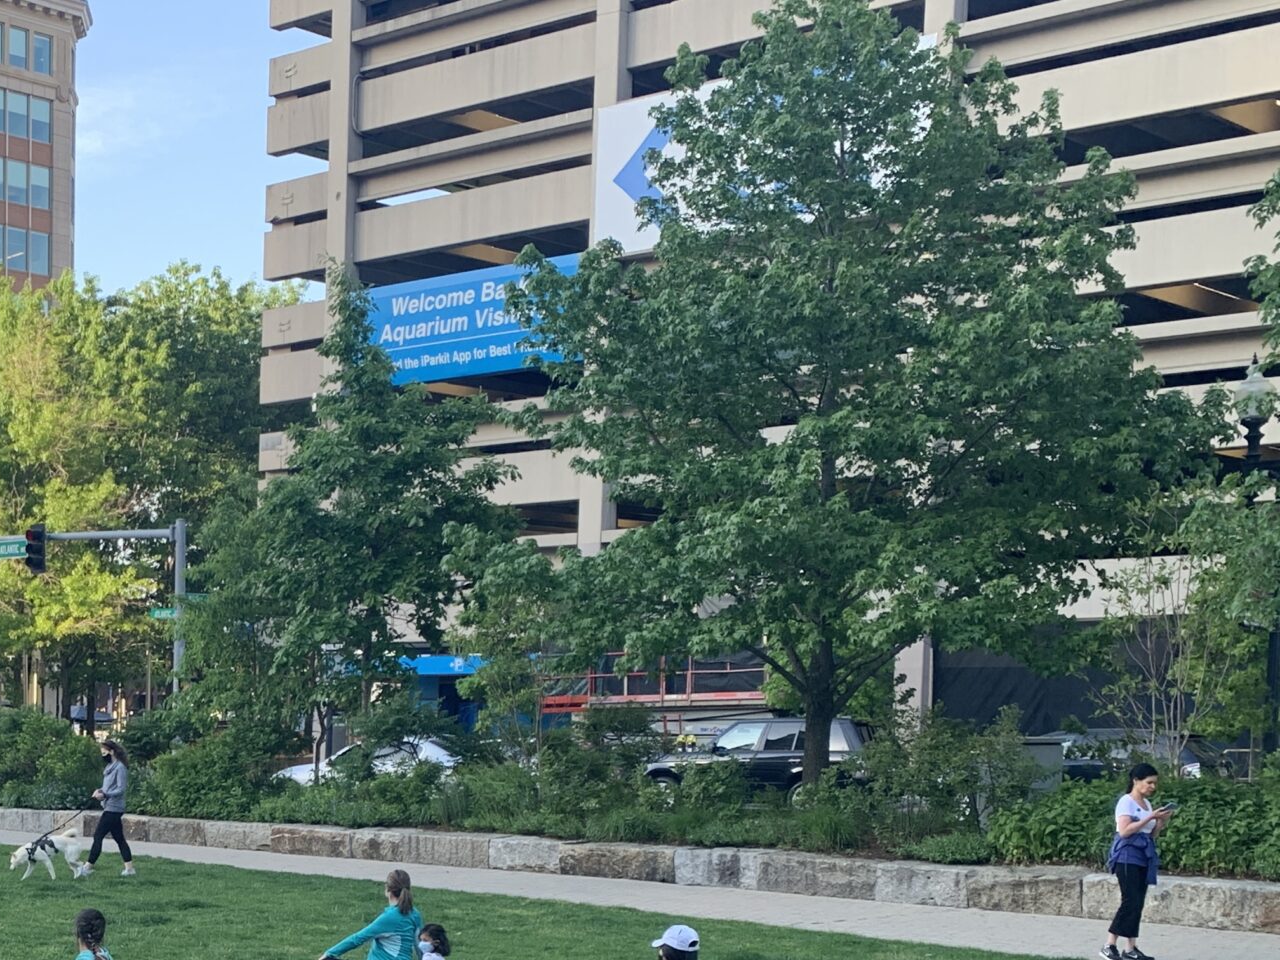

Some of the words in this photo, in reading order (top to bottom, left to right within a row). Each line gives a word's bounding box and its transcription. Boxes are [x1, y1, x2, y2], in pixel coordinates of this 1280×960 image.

[391, 288, 475, 317] Welcome
[379, 315, 469, 346] Aquarium
[404, 356, 419, 370] the
[420, 351, 451, 367] iParkit
[452, 349, 472, 366] App
[473, 347, 487, 360] for
[489, 343, 512, 358] Best
